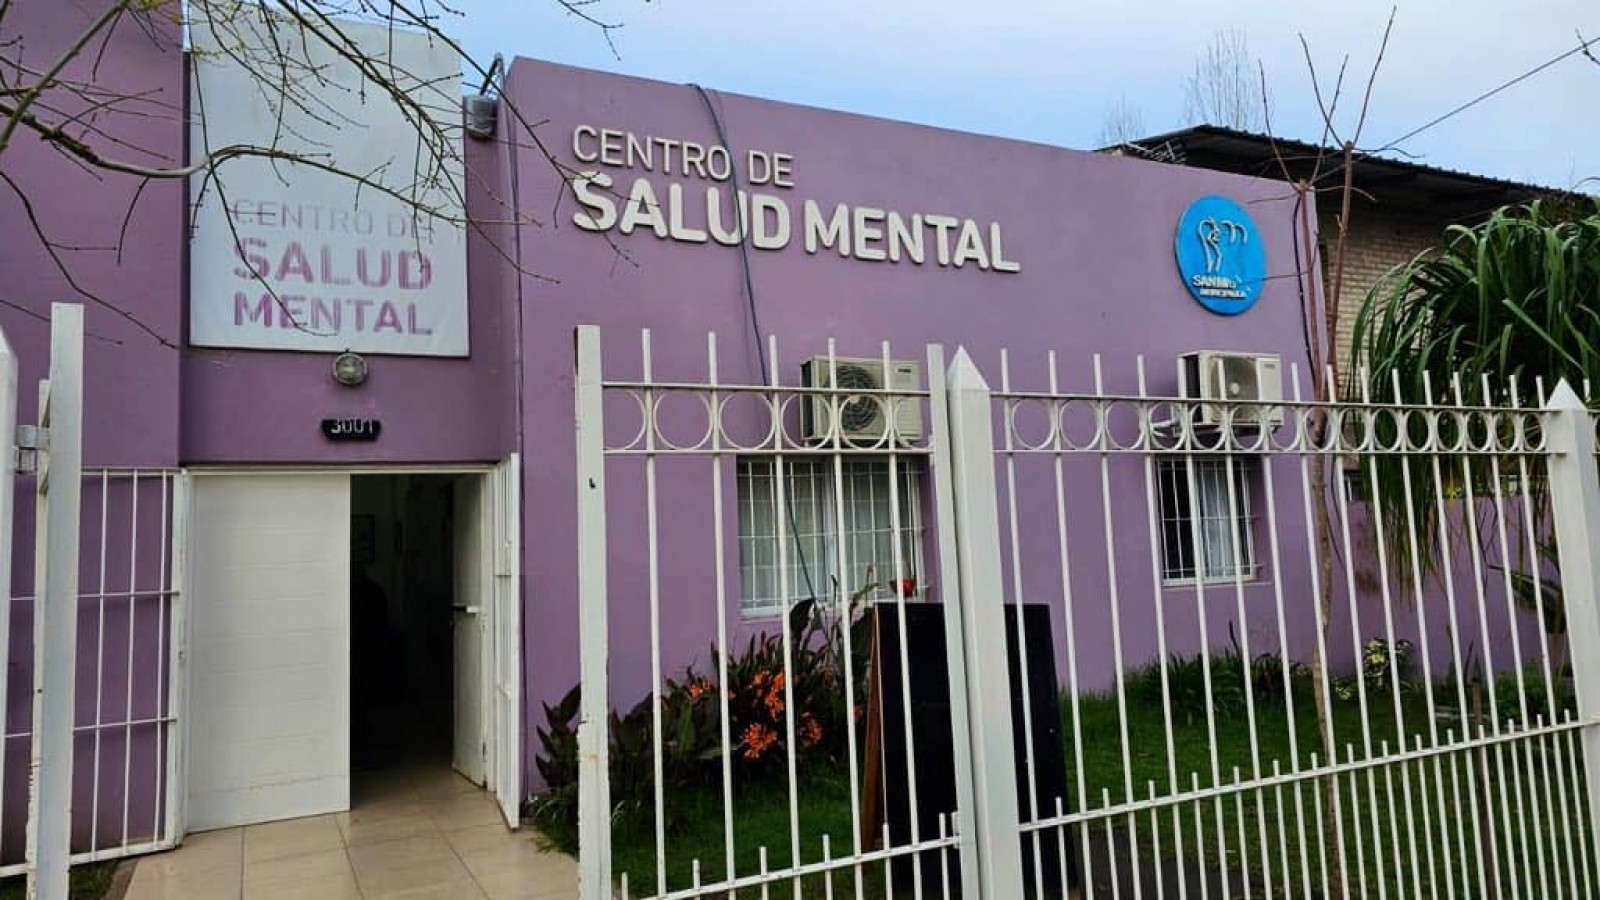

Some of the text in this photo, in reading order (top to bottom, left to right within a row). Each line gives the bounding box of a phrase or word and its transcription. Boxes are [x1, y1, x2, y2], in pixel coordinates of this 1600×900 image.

[572, 124, 795, 188] CENTRO DE
[233, 199, 373, 235] CENTRO
[572, 172, 1021, 273] SALUD MENTAL
[233, 237, 433, 290] SALUD
[233, 290, 434, 336] MENTAL
